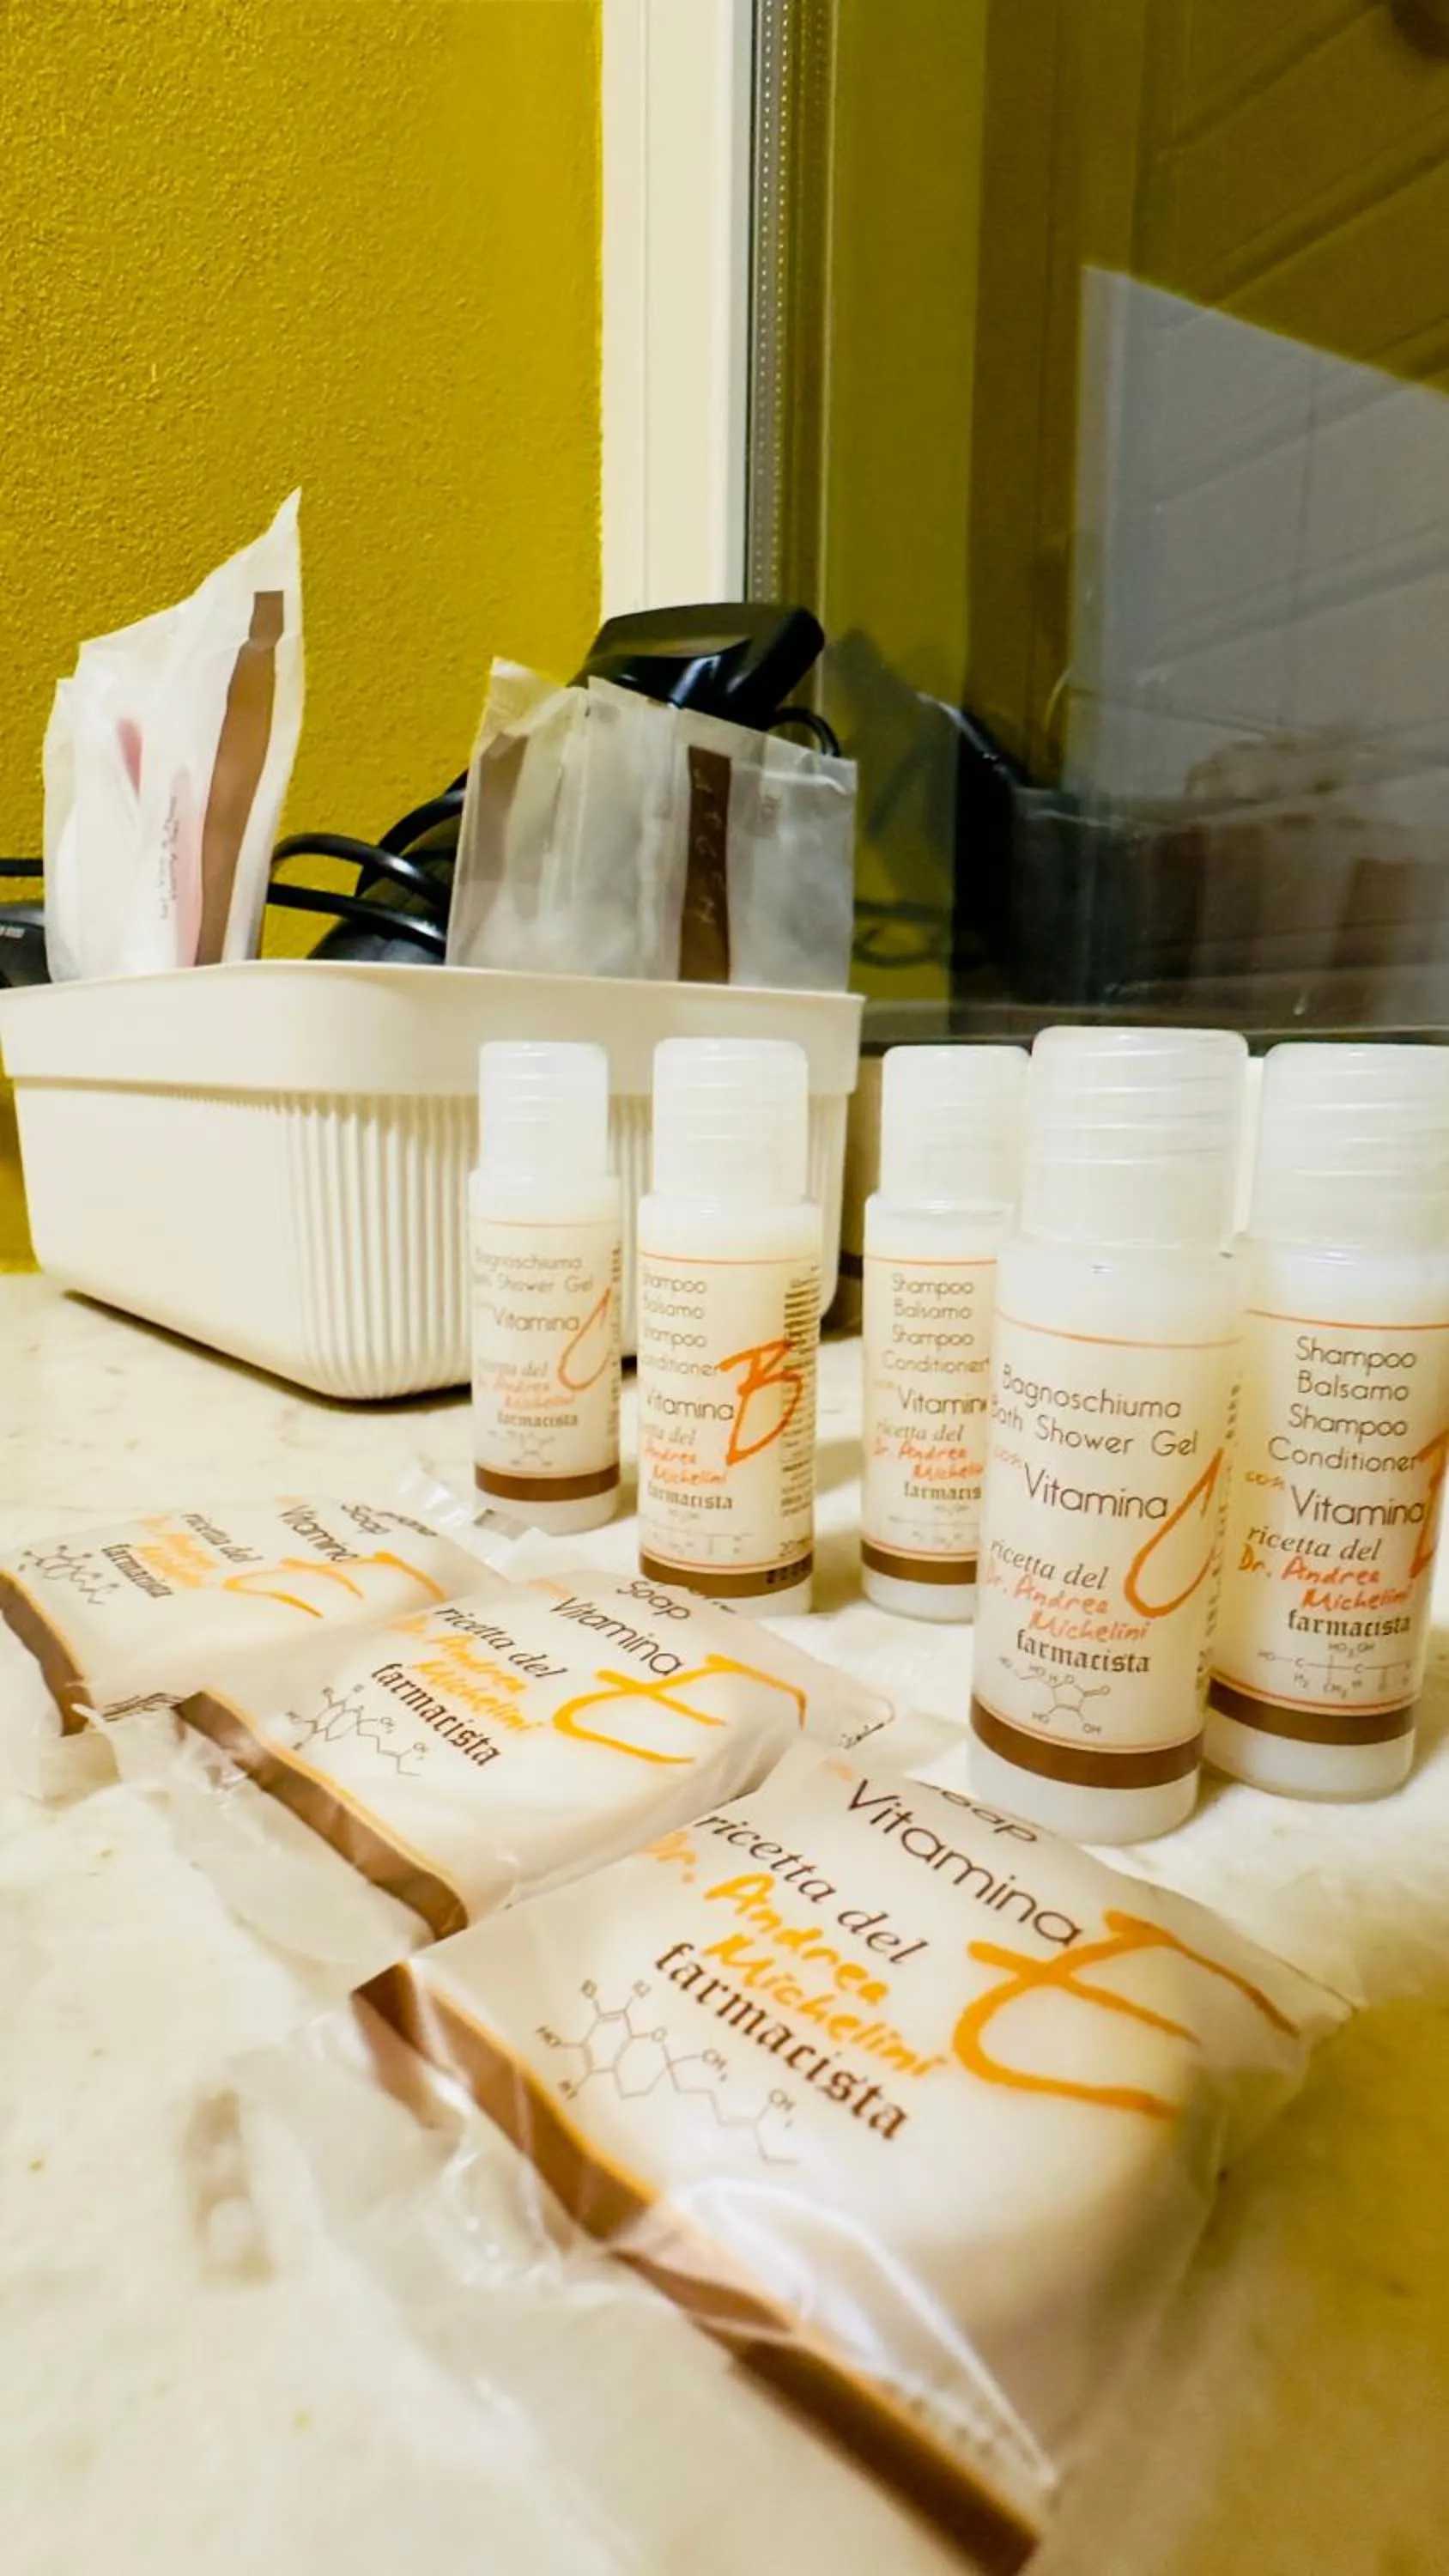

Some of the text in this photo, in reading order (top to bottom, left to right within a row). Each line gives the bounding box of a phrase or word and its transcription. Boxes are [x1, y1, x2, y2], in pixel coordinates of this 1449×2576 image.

[564, 1273, 594, 1293] Gel
[891, 1272, 975, 1297] Shampoo
[492, 1305, 581, 1332] Vitamina
[894, 1297, 973, 1321] Balsamo
[892, 1323, 975, 1352] Shampoo
[1295, 1334, 1416, 1376] Shampoo
[646, 1388, 735, 1422] Vitamina
[715, 1337, 804, 1467] B
[1001, 1363, 1183, 1419] Bagnoschiuma
[1297, 1370, 1410, 1402] Balsamo
[931, 1422, 965, 1443] del
[1034, 1414, 1135, 1455] Shower
[1150, 1428, 1199, 1456] Gel
[1288, 1402, 1408, 1444] Shampoo
[1267, 1436, 1417, 1473] Conditioner
[647, 1479, 734, 1511] farmacista
[903, 1479, 983, 1502] farmacis
[1023, 1461, 1169, 1520] Vitamina
[1290, 1484, 1426, 1527] Vitamina
[1238, 1543, 1381, 1585] Dr. Andrea
[1247, 1525, 1382, 1562] ricetta del
[990, 1540, 1110, 1590] ricetta del
[615, 1580, 692, 1620] Soap
[1012, 1573, 1110, 1615] Andrea
[433, 1607, 516, 1651] ricetta
[508, 1653, 570, 1679] del
[549, 1596, 685, 1676] Vitamina
[1028, 1610, 1152, 1644] Michelini
[1288, 1608, 1410, 1637] farmacista
[1016, 1628, 1152, 1674] farmacista
[371, 1662, 501, 1767] farmacista
[915, 1779, 1039, 1843] oap
[847, 1777, 1083, 1947] Vitamina
[694, 1813, 930, 1966] ricetta del
[702, 1871, 889, 2008] Andrea
[700, 1931, 948, 2078] Michelini
[654, 1941, 909, 2142] farmacista
